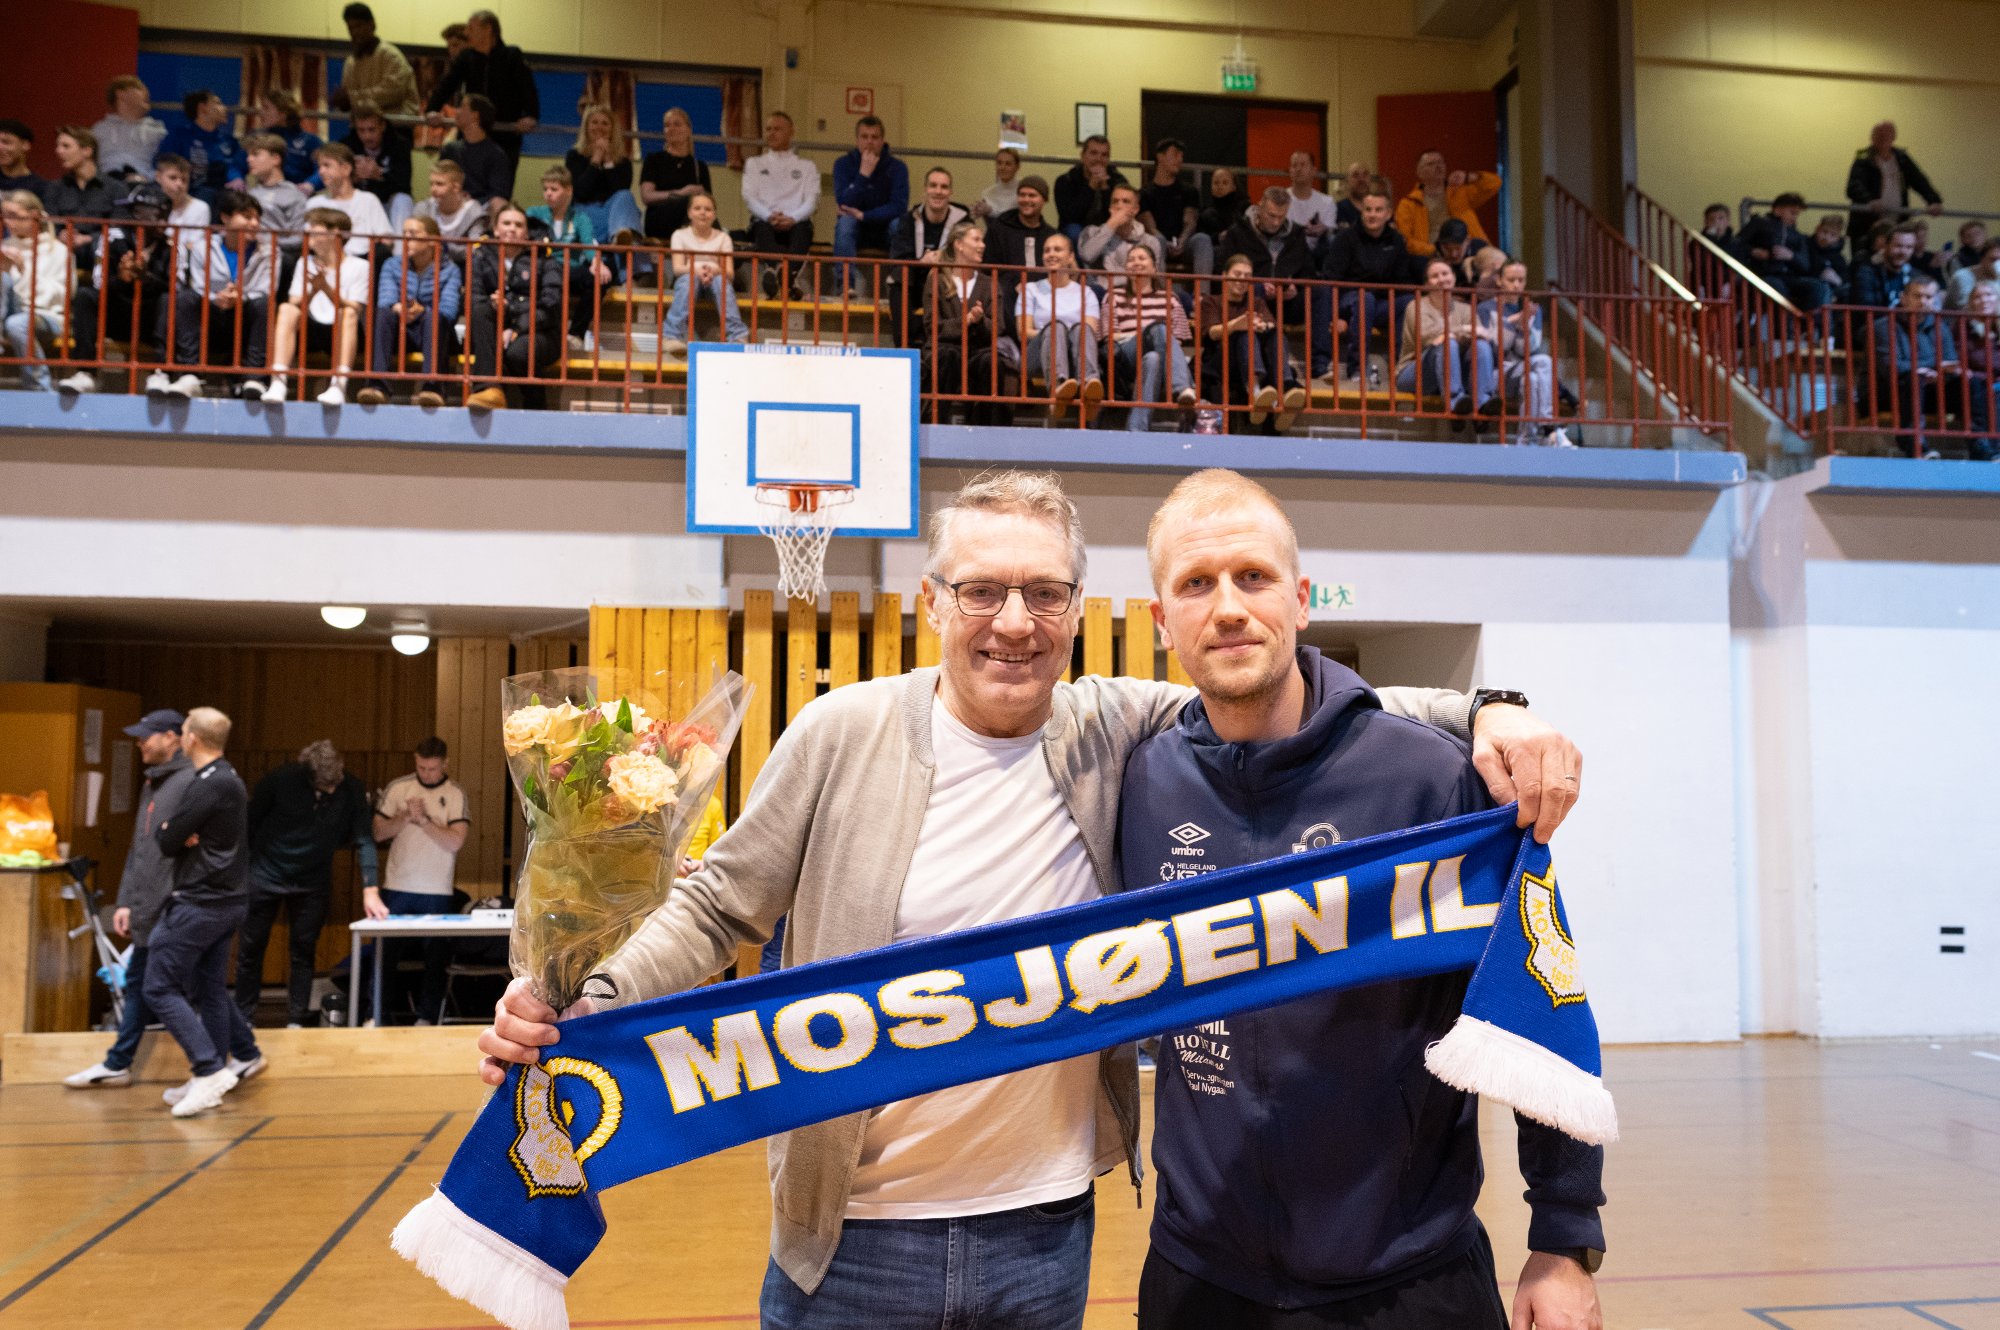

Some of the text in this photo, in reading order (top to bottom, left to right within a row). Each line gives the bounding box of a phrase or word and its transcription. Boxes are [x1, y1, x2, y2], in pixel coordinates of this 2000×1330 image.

[1171, 846, 1205, 856] umbro
[1176, 862, 1217, 871] HELGELAND
[643, 854, 1499, 1115] MOSJØEN IL
